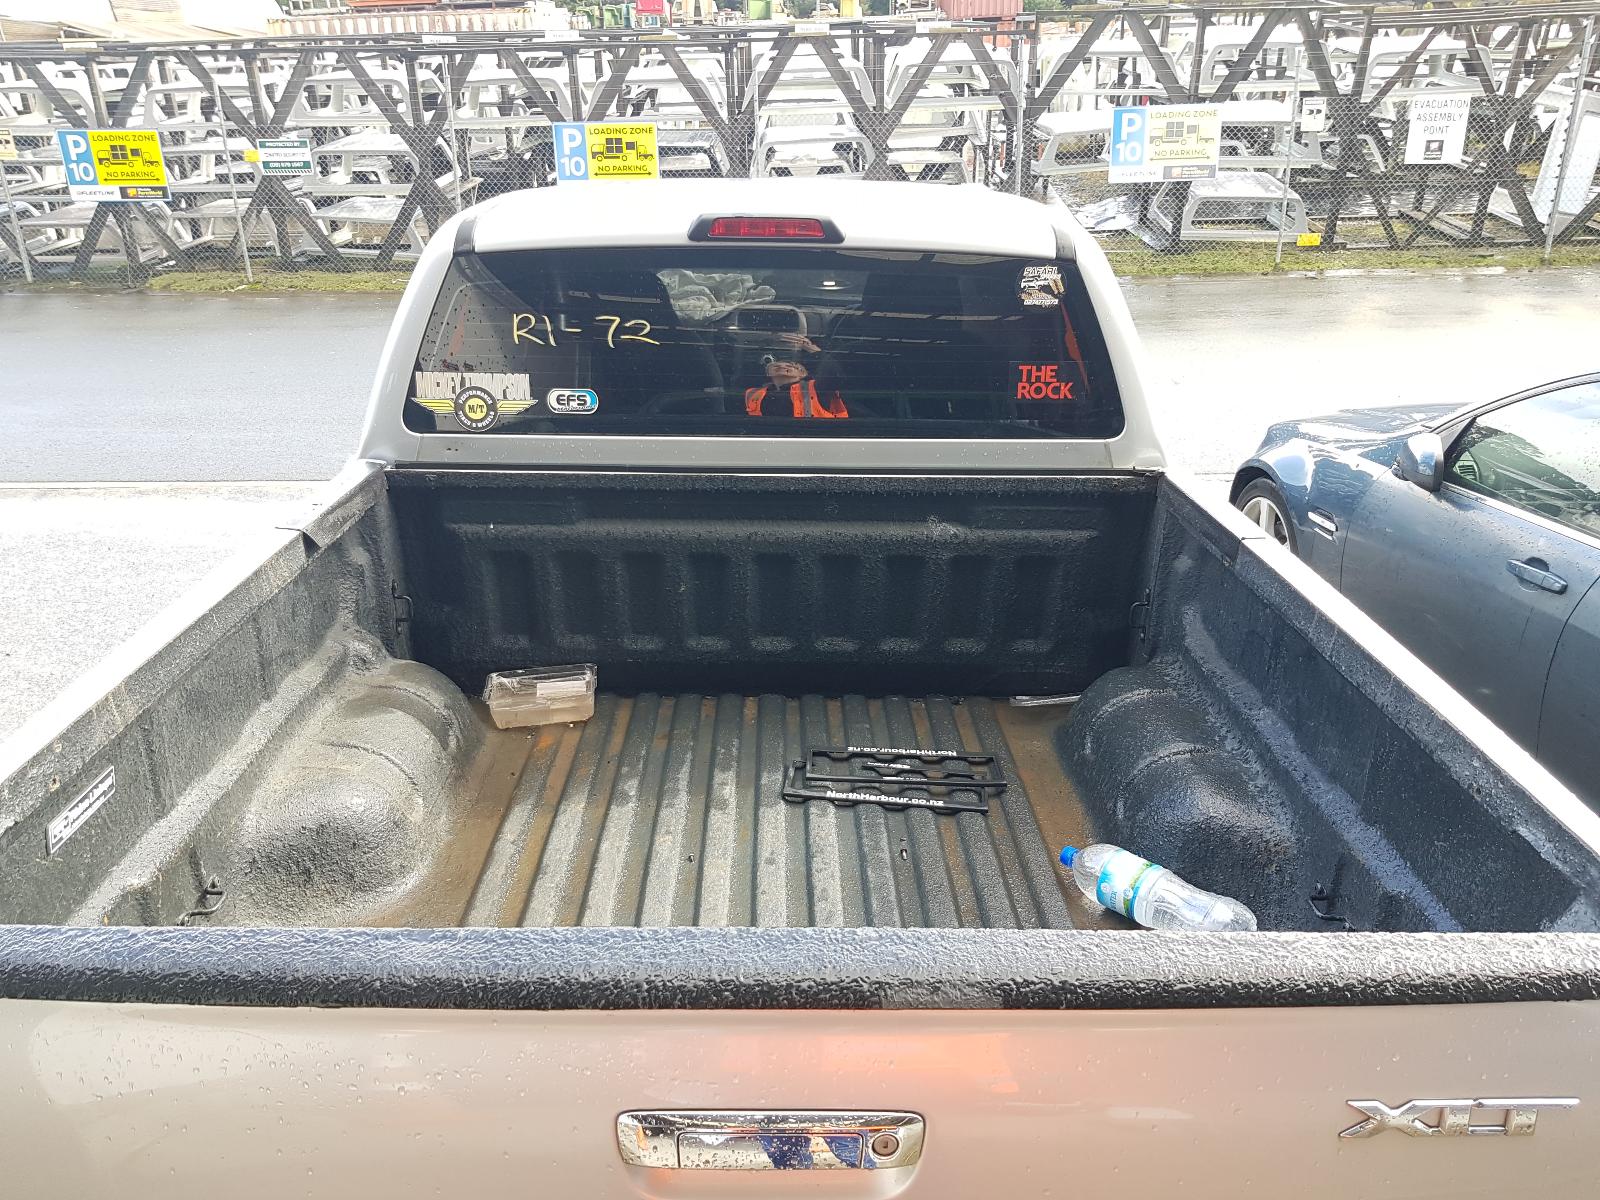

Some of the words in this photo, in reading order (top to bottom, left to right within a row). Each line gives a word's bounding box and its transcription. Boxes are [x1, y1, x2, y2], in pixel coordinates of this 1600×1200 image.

[1414, 100, 1468, 108] EVACUATION
[1193, 109, 1217, 117] ZONE
[1416, 113, 1463, 121] ASSEMBLY
[589, 127, 627, 135] LOADING
[1121, 112, 1142, 140] P
[1423, 126, 1450, 134] POINT
[65, 134, 87, 160] P
[562, 128, 582, 155] P
[1115, 141, 1142, 162] 10
[68, 162, 94, 182] 10
[560, 156, 585, 177] 10
[1018, 365, 1058, 383] THE
[415, 371, 461, 399] MICKEY
[1017, 382, 1074, 399] ROCK
[467, 404, 485, 414] M/T
[556, 394, 588, 407] EFS
[826, 790, 944, 806] NorthHarbour.co.nz
[1338, 1098, 1580, 1138] XLT
